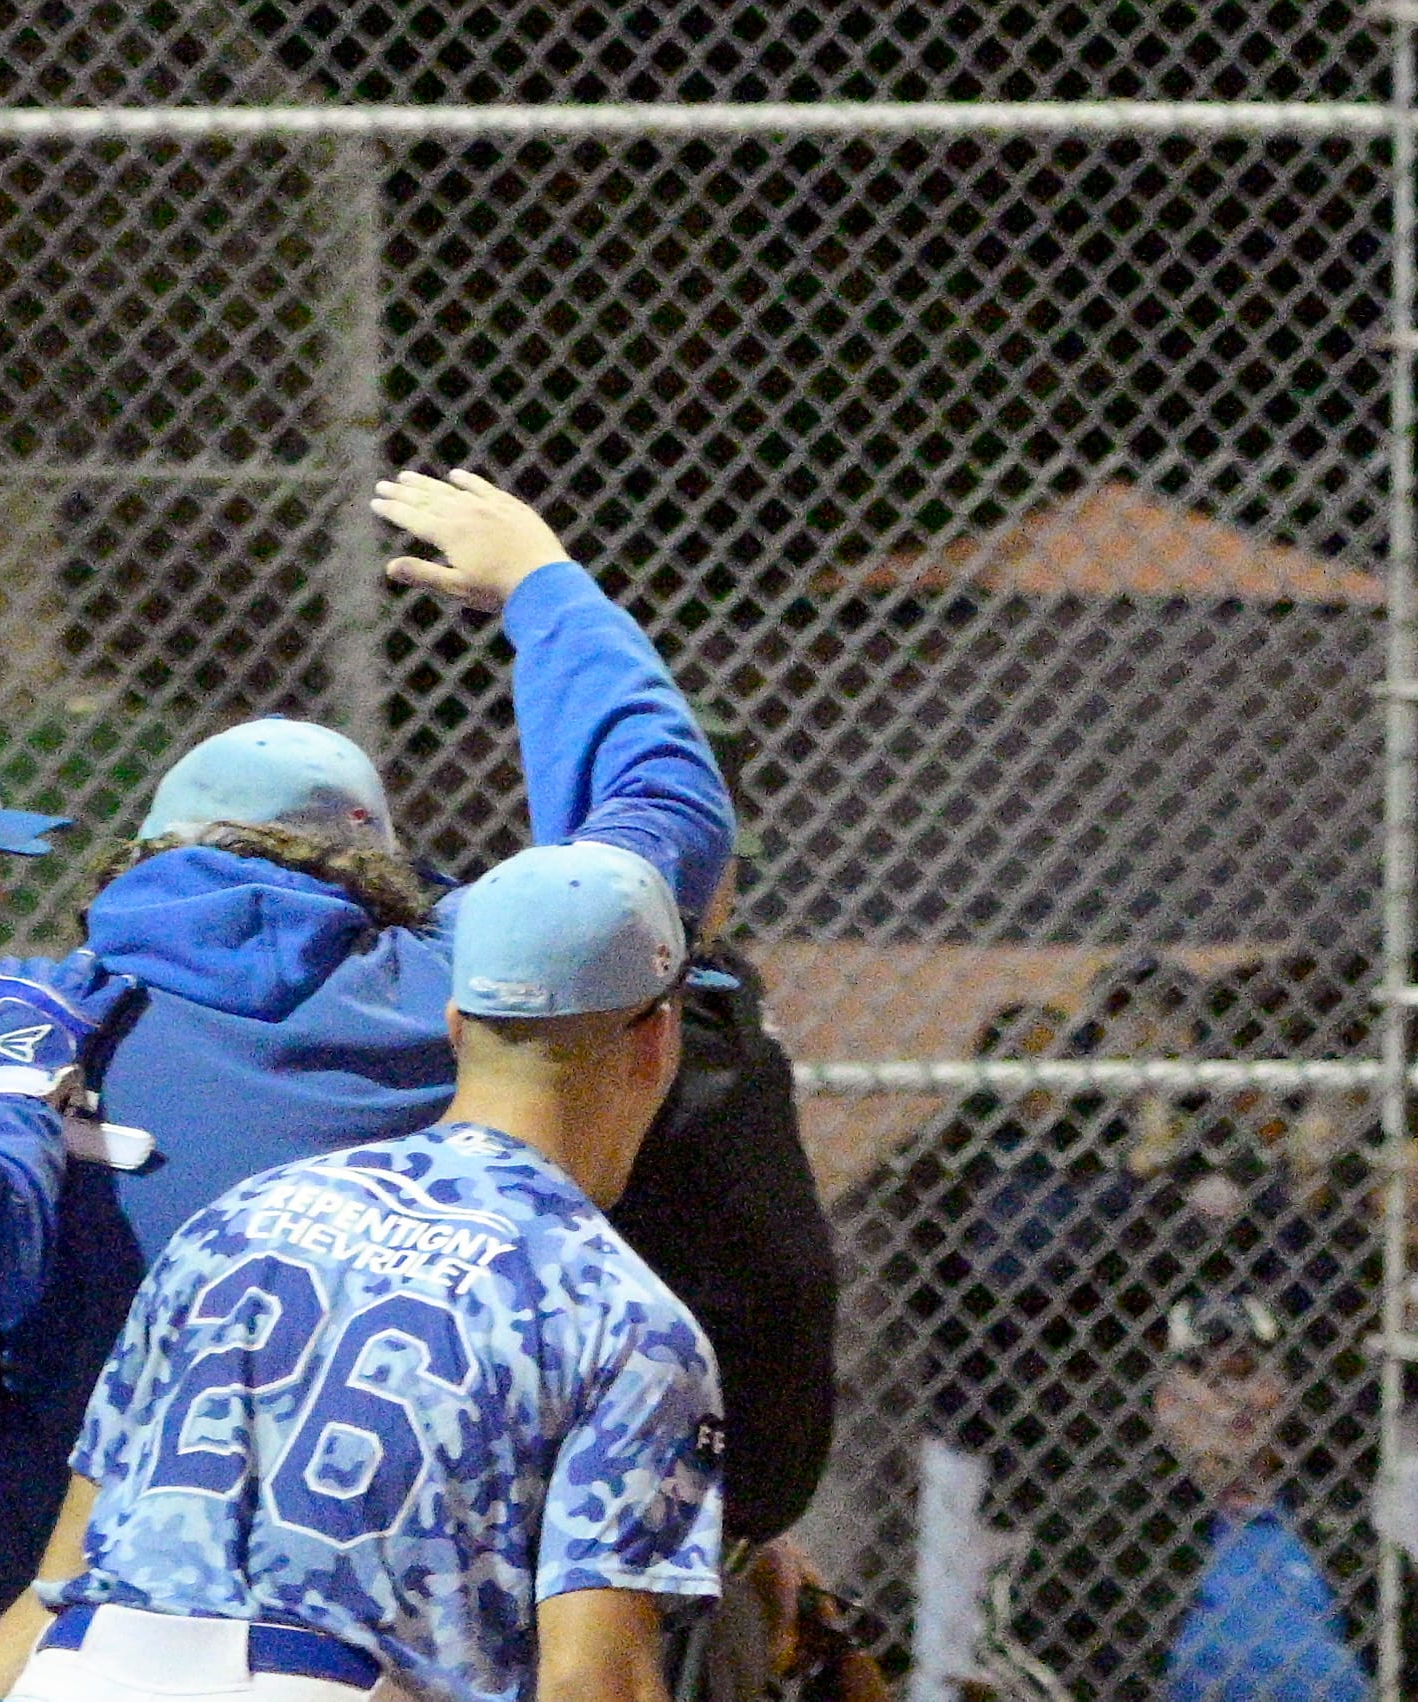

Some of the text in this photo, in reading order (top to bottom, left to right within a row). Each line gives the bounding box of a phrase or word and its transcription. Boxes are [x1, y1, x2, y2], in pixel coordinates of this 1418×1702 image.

[245, 1210, 492, 1295] CHEVROLET
[262, 1185, 519, 1266] REPENTIGNY
[138, 1250, 479, 1549] 26
